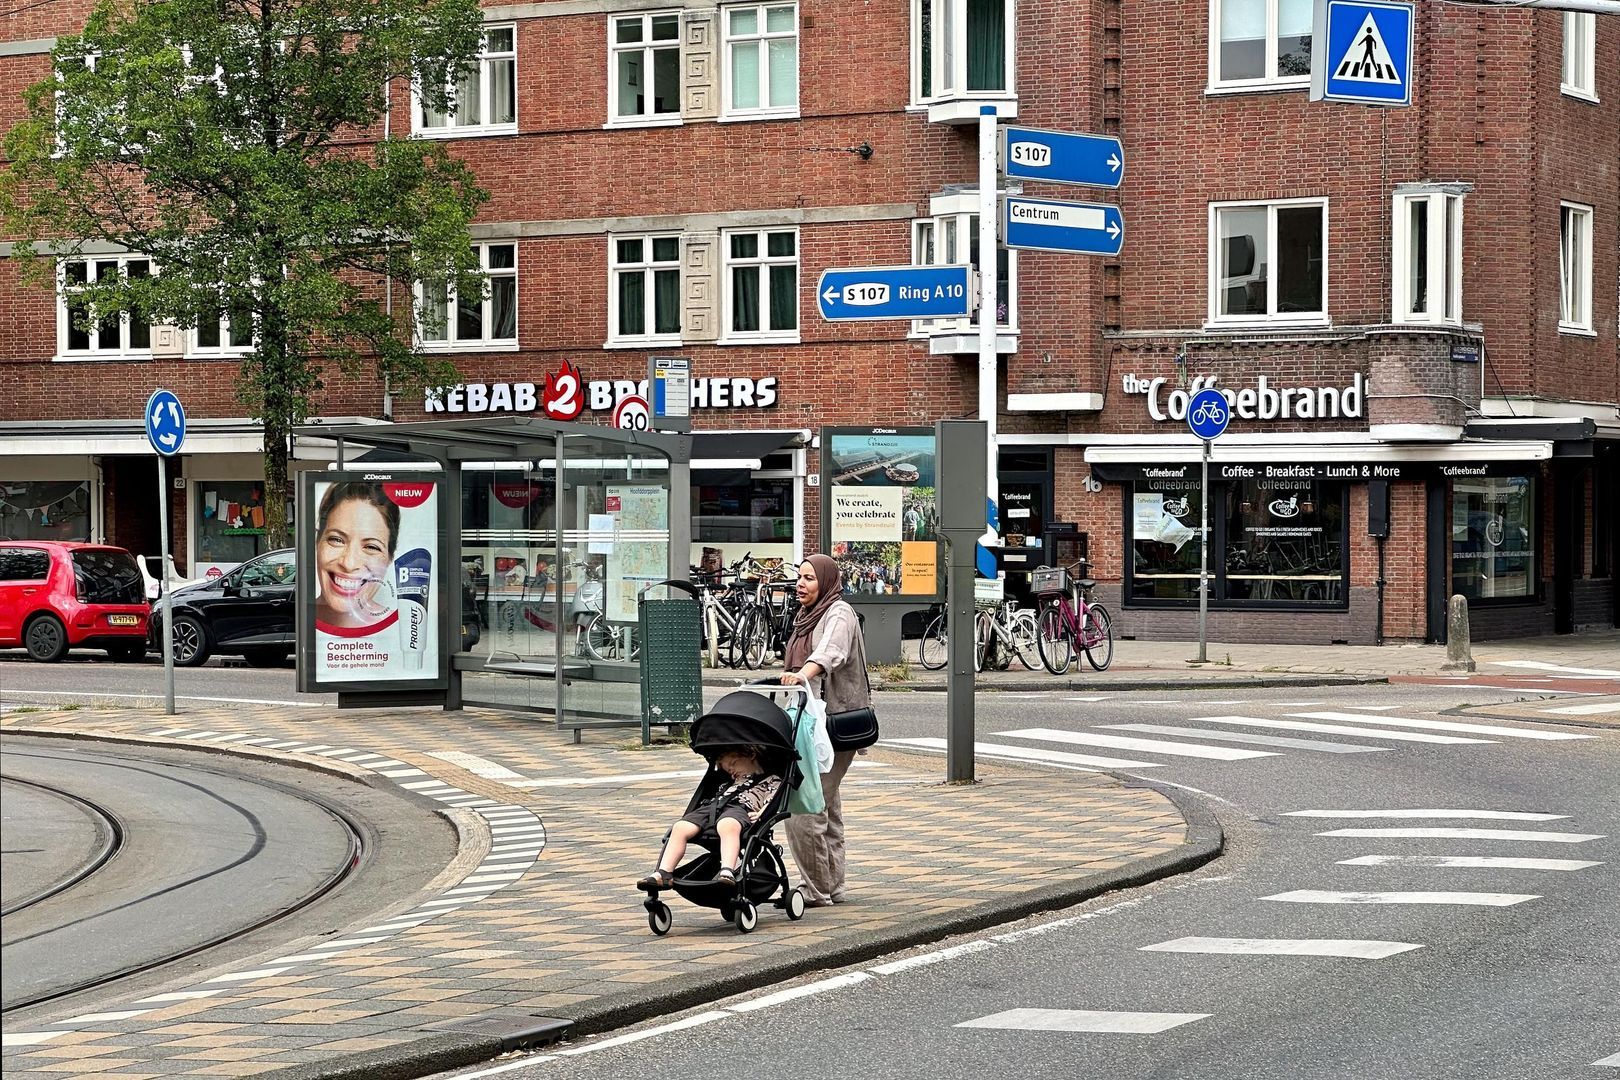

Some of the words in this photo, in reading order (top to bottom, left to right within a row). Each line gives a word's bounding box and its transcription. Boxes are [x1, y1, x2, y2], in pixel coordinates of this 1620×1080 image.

[1014, 146, 1022, 159] S
[1025, 147, 1047, 161] 107
[1012, 205, 1059, 220] Centrum
[848, 288, 855, 300] S
[859, 287, 886, 300] 107
[899, 286, 930, 302] Ring
[934, 284, 963, 298] A10
[1122, 374, 1150, 394] the
[425, 382, 537, 412] KEBAB
[547, 374, 577, 414] 2
[622, 412, 647, 431] 30
[1222, 465, 1254, 477] Coffee
[1266, 465, 1315, 477] Breakfast
[1326, 465, 1358, 477] Lunch
[1362, 465, 1371, 477] &
[1374, 465, 1400, 477] More
[810, 476, 818, 484] 18
[1082, 475, 1102, 493] 16
[395, 489, 423, 498] NIEUW
[836, 499, 847, 507] We
[852, 499, 882, 508] create,
[854, 509, 896, 519] celebrate
[399, 567, 409, 583] B
[410, 607, 418, 649] PRODENT
[327, 642, 374, 651] Complete
[327, 652, 389, 661] Bescherming
